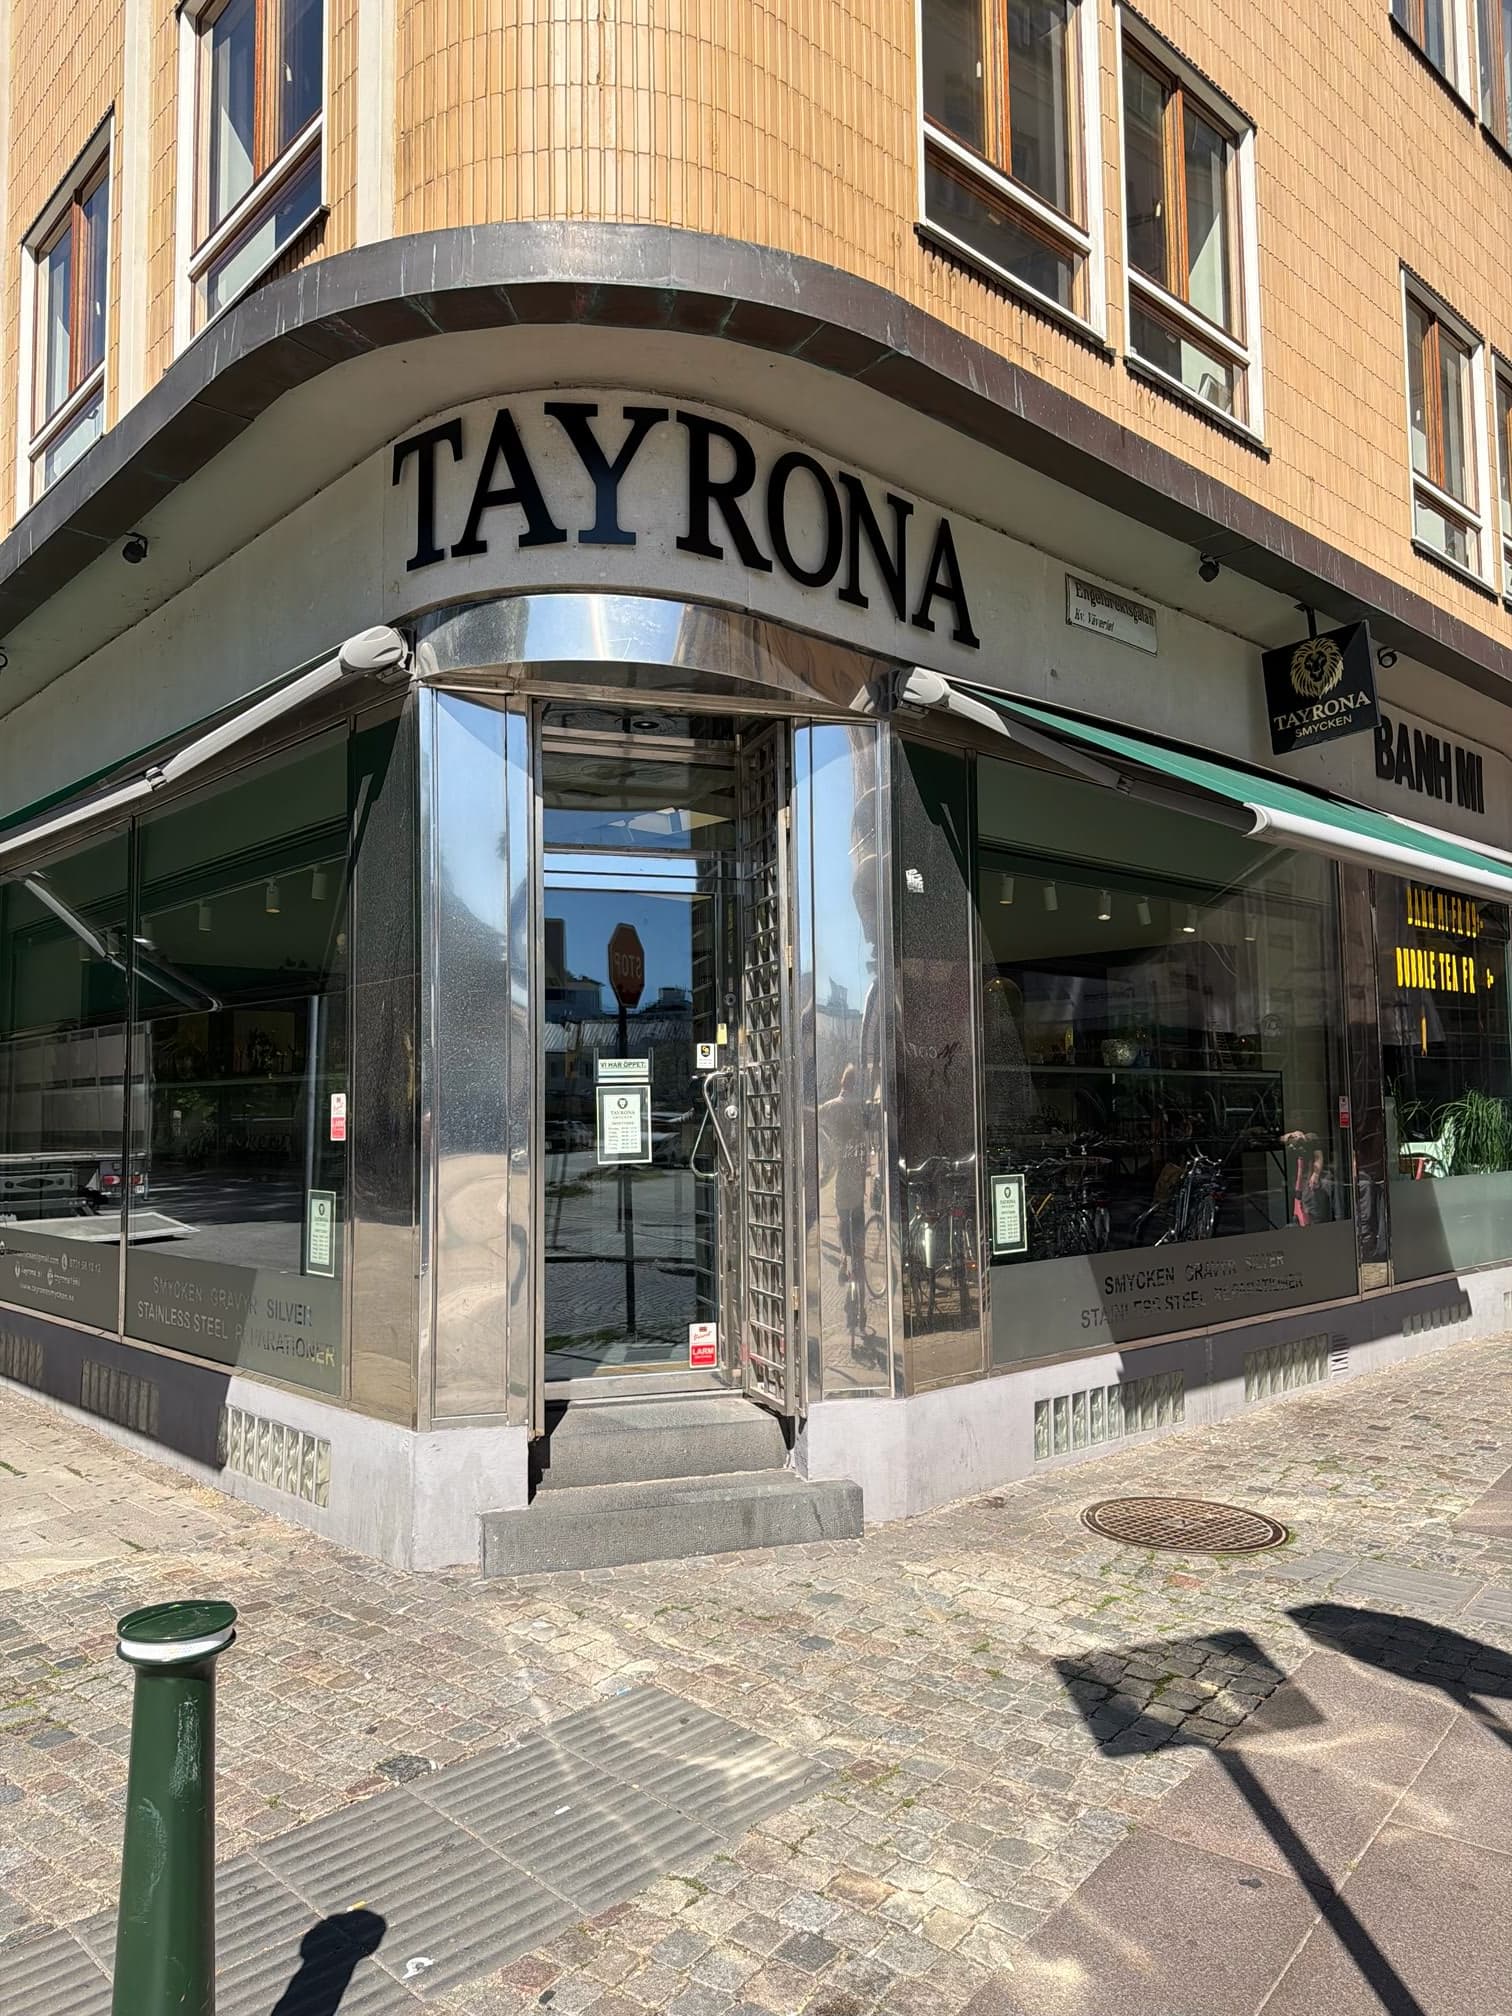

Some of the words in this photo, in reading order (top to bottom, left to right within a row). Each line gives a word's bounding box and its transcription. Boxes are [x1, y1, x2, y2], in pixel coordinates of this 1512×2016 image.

[392, 401, 980, 650] TAYRONA
[1075, 582, 1155, 628] Engelbrektsgatan
[1273, 690, 1372, 732] TAYRONA
[1294, 714, 1353, 739] SMYCKEN
[1373, 714, 1453, 805] BANH
[1454, 746, 1485, 815] MI
[1396, 946, 1437, 990] BUBBLE
[1439, 952, 1459, 993] TEA
[1462, 956, 1476, 994] FR
[608, 1061, 622, 1069] HAR
[152, 1276, 202, 1303] SMYCKEN
[211, 1287, 258, 1316] GRAVYR
[266, 1298, 313, 1328] SILVER
[1104, 1266, 1176, 1296] SMYCKEN
[137, 1300, 191, 1330] STAINLESS
[193, 1315, 229, 1340] STEEL
[692, 1347, 715, 1356] LARM
